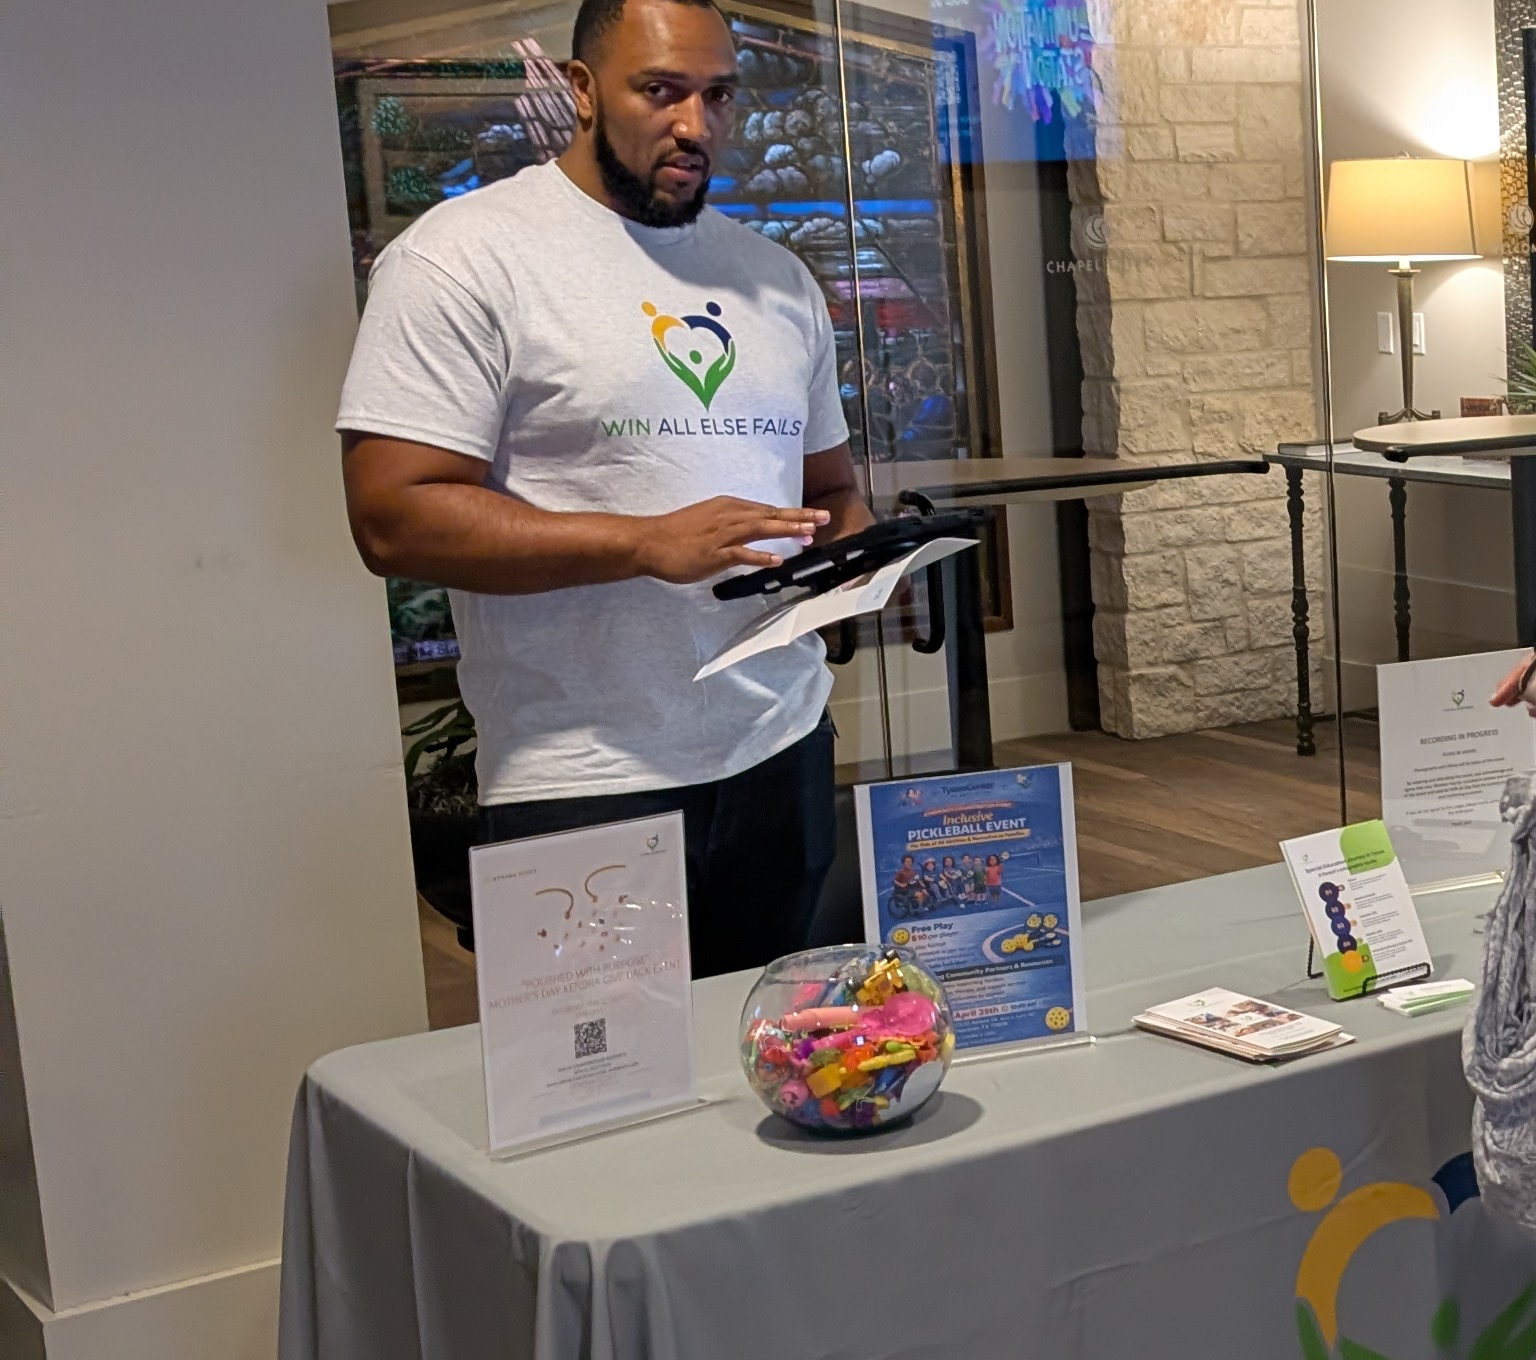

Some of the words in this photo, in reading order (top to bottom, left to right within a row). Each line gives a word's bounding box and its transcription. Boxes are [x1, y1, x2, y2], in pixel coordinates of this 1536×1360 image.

[1046, 259, 1102, 274] CHAPEL
[601, 418, 650, 437] WIN
[658, 418, 696, 435] ALL
[700, 418, 748, 436] ELSE
[753, 418, 803, 437] FAILS
[943, 811, 994, 825] Inclusive
[907, 823, 983, 841] PICKLEBALL
[986, 817, 1027, 832] EVENT
[911, 924, 932, 934] Free
[933, 922, 954, 932] Play
[954, 1009, 977, 1020] April
